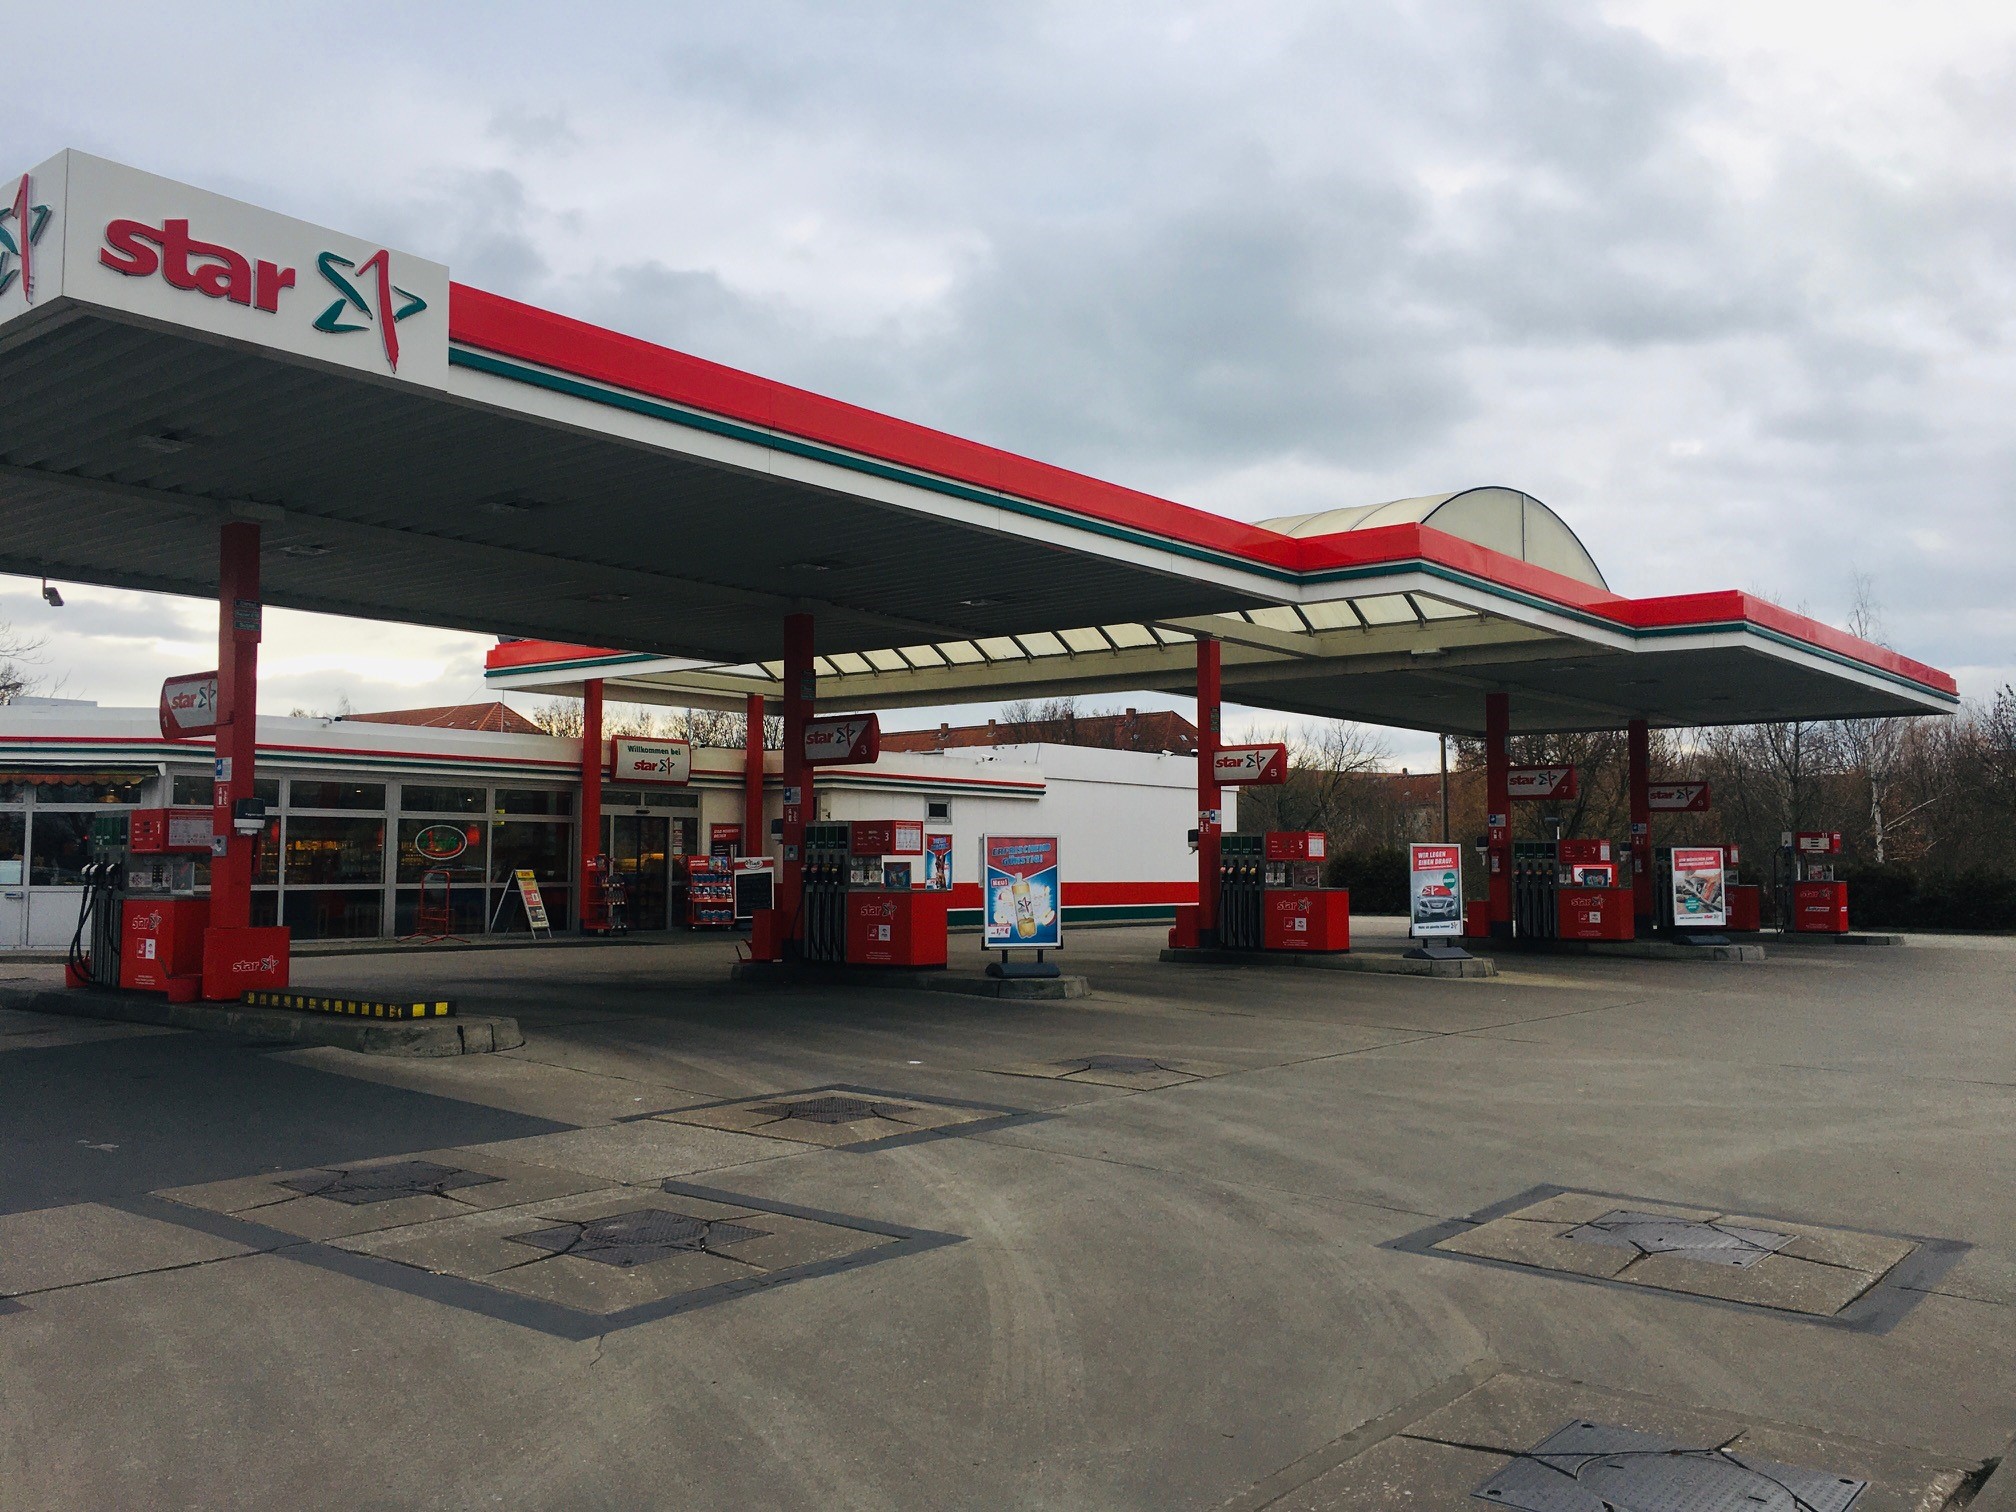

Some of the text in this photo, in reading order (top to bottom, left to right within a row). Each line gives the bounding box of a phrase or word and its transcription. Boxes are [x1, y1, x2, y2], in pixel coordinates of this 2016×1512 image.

[99, 218, 296, 314] star
[170, 692, 197, 710] star
[805, 731, 834, 745] star
[627, 745, 681, 756] Willkommen bei
[860, 745, 867, 755] 3
[633, 760, 658, 771] star
[1214, 756, 1243, 768] star
[1270, 768, 1277, 777] 5
[1509, 775, 1536, 786] star
[1649, 791, 1674, 799] star
[884, 832, 890, 842] 3
[1298, 841, 1304, 850] 5
[860, 904, 881, 916] star
[1276, 900, 1297, 910] star
[132, 915, 149, 930] star
[232, 960, 259, 973] star
